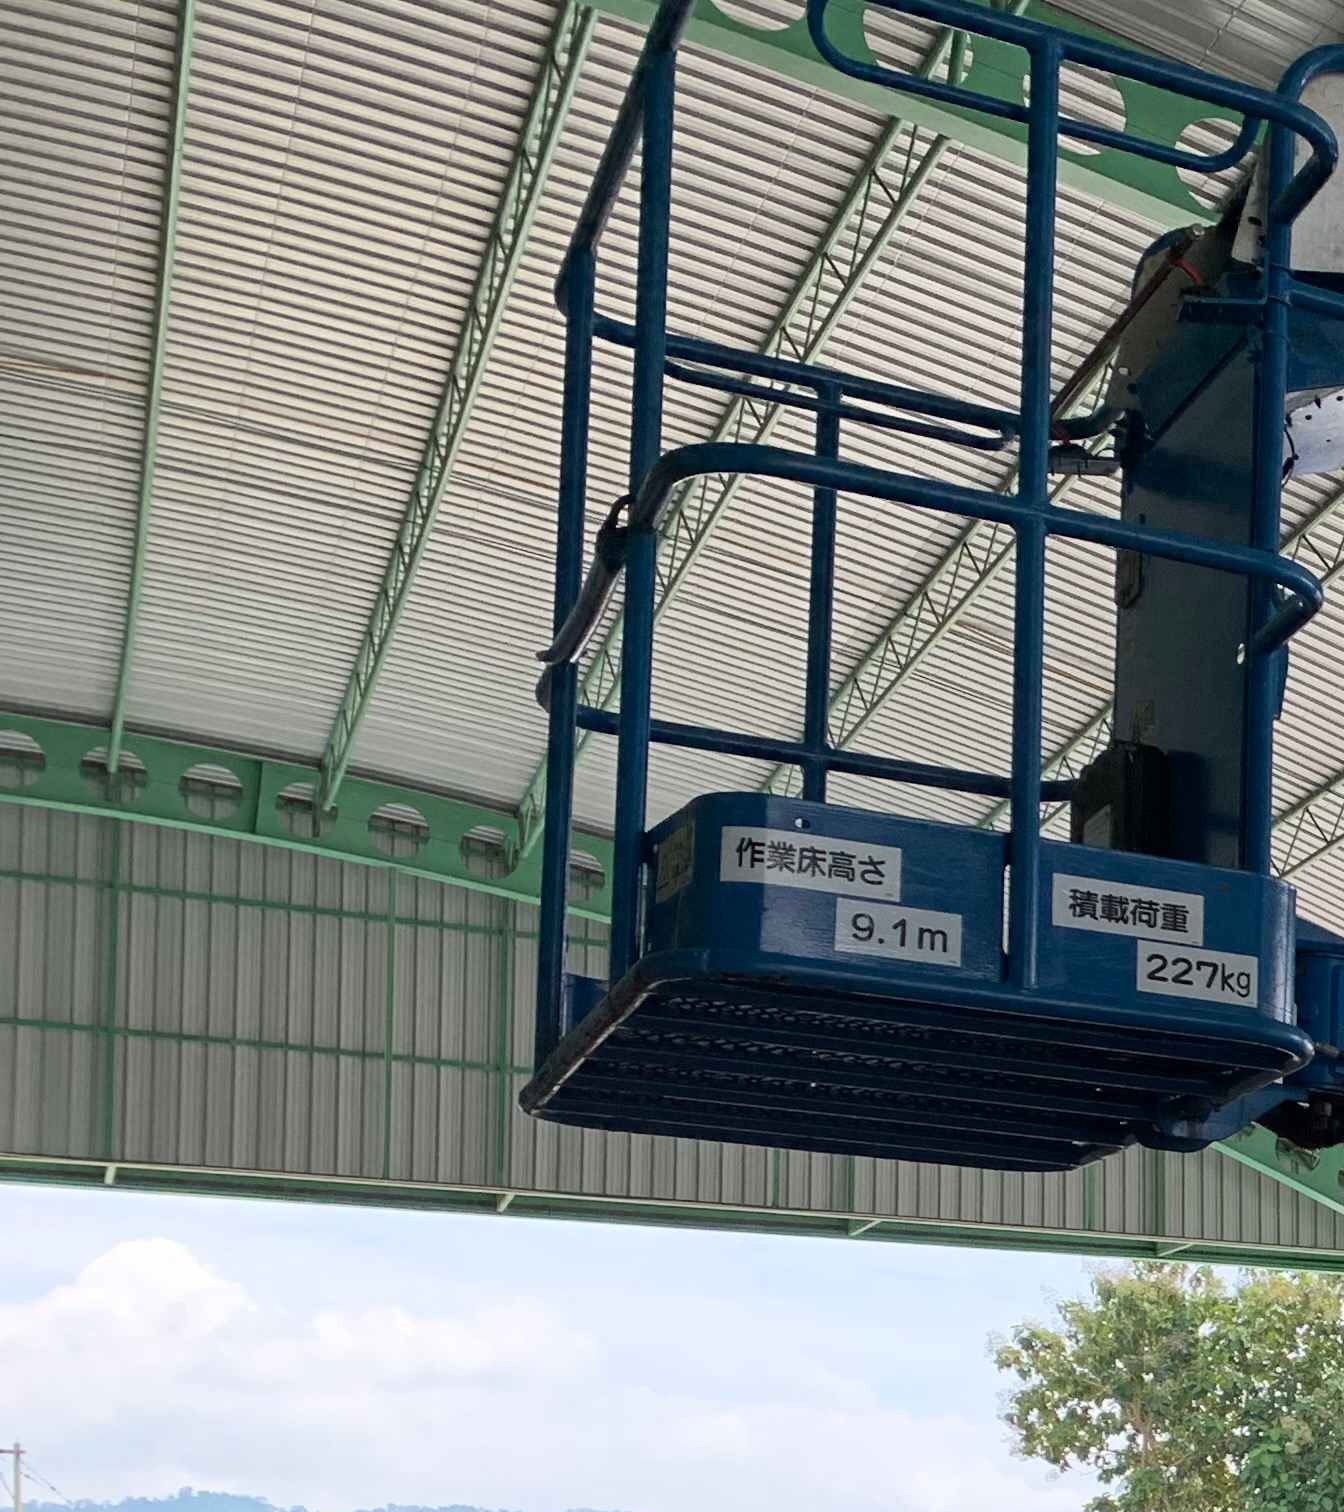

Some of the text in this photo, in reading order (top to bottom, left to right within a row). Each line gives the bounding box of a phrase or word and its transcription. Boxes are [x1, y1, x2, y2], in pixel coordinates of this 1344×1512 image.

[735, 836, 887, 886] 作業床高さ
[850, 912, 949, 953] 9.1m
[1068, 888, 1190, 934] 積載荷重
[1146, 953, 1251, 998] 227kg
